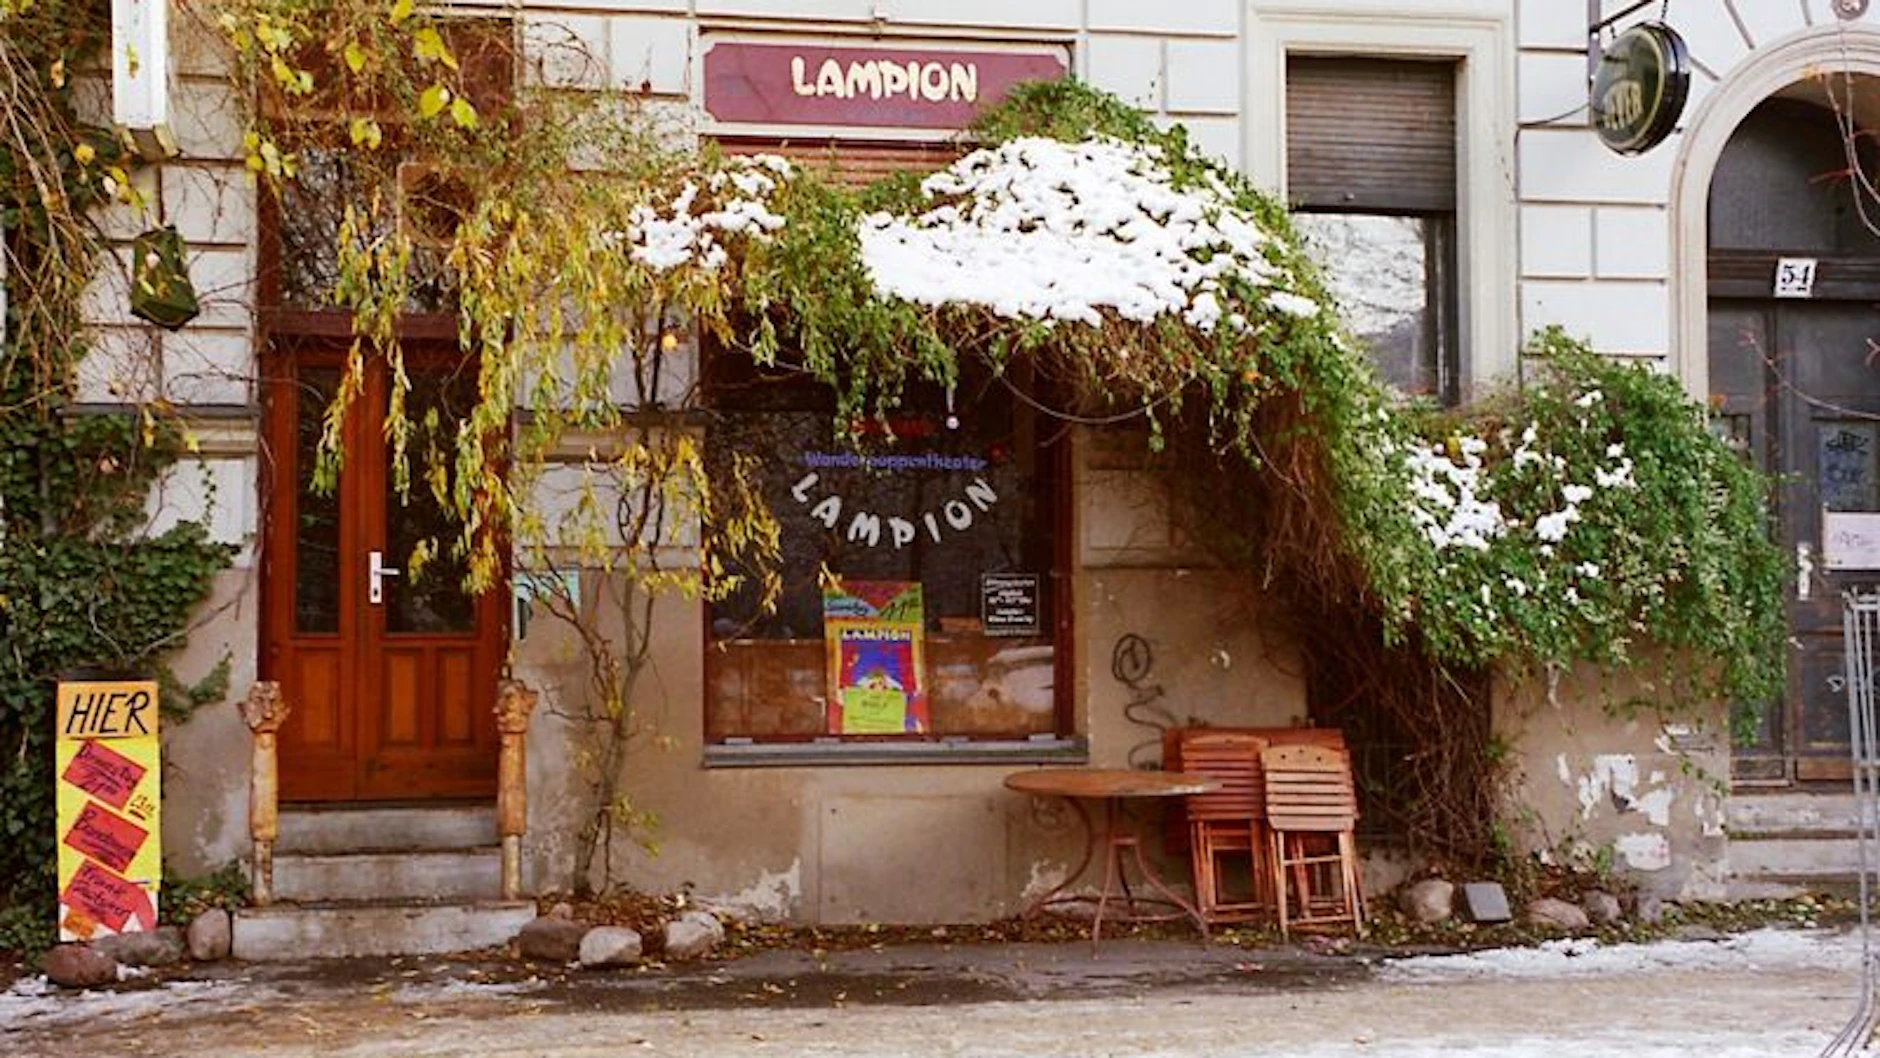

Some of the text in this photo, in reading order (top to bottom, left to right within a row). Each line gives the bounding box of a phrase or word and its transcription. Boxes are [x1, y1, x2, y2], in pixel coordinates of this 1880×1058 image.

[790, 55, 978, 103] LAMPION
[1781, 263, 1811, 286] 54
[790, 471, 999, 550] LAMPION
[65, 691, 150, 736] HIER
